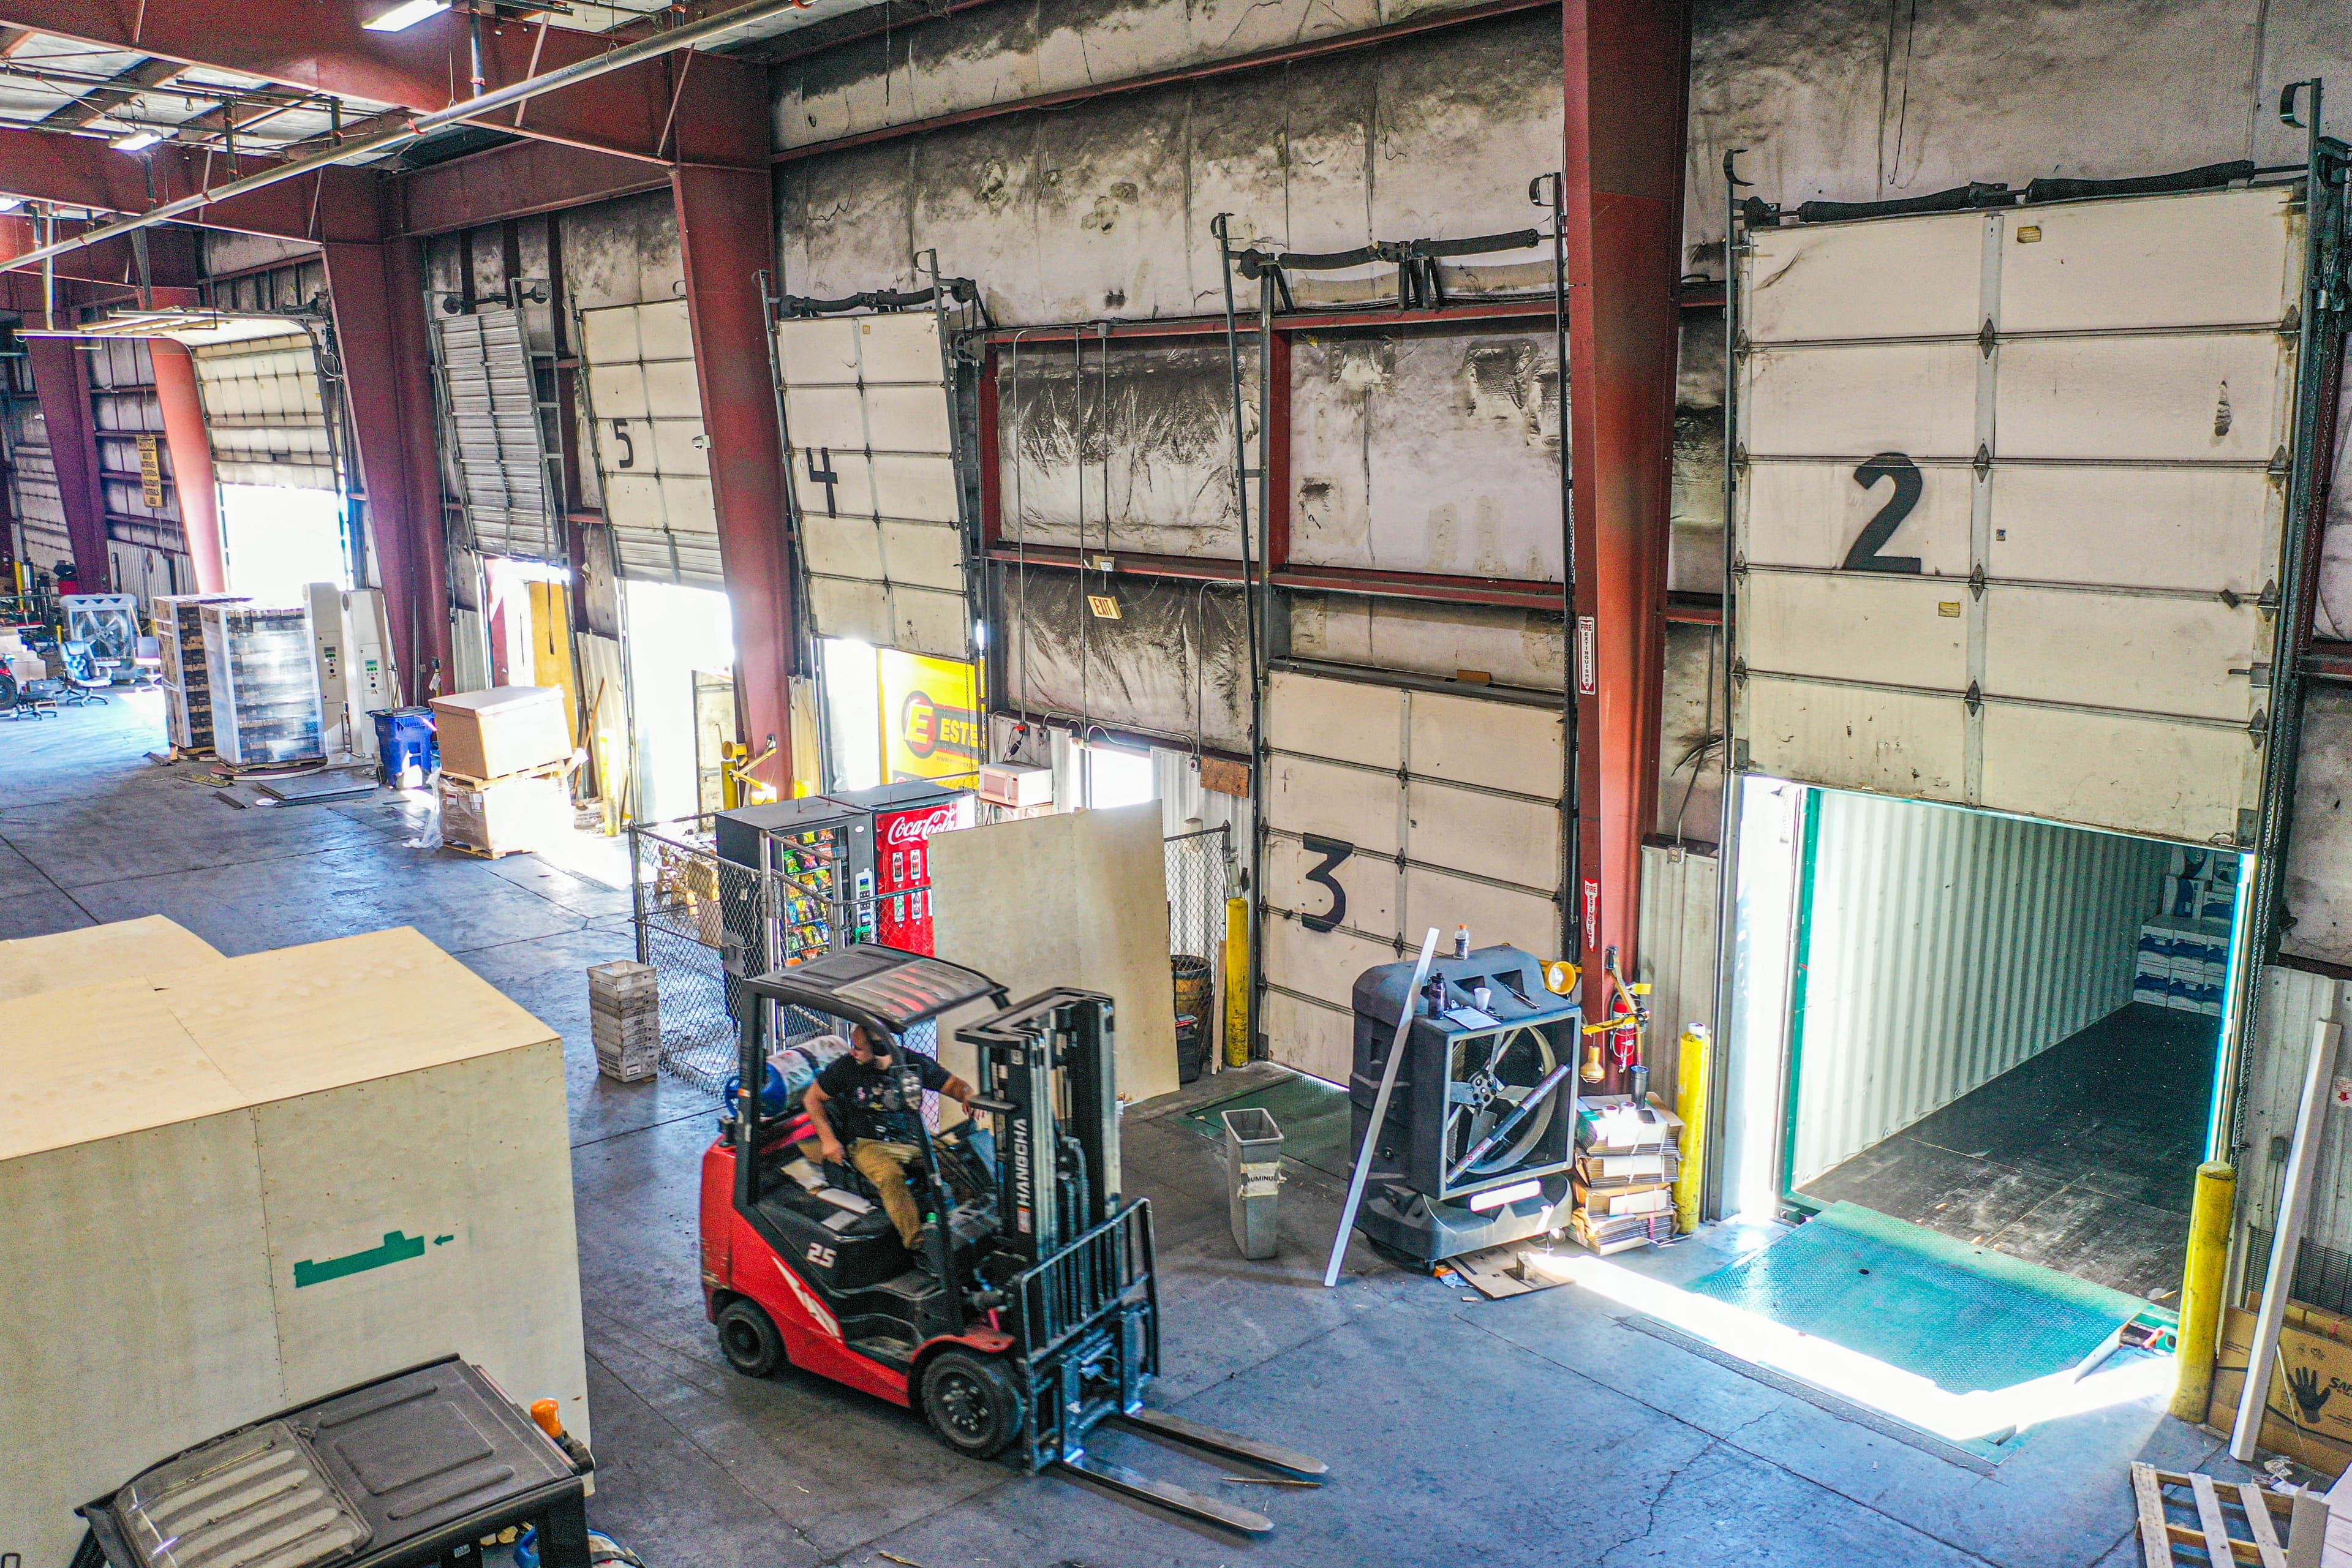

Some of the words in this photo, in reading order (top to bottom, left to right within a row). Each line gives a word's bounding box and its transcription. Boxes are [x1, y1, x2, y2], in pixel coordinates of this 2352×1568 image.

[613, 418, 633, 468] 5
[806, 447, 838, 519] 4
[1841, 451, 1923, 575] 2
[1092, 597, 1113, 617] EXIT
[940, 718, 979, 748] ESTE
[1302, 832, 1354, 933] 3
[1585, 884, 1597, 894] FIRE
[1014, 1118, 1030, 1207] HANGCHA
[806, 1242, 837, 1268] 25
